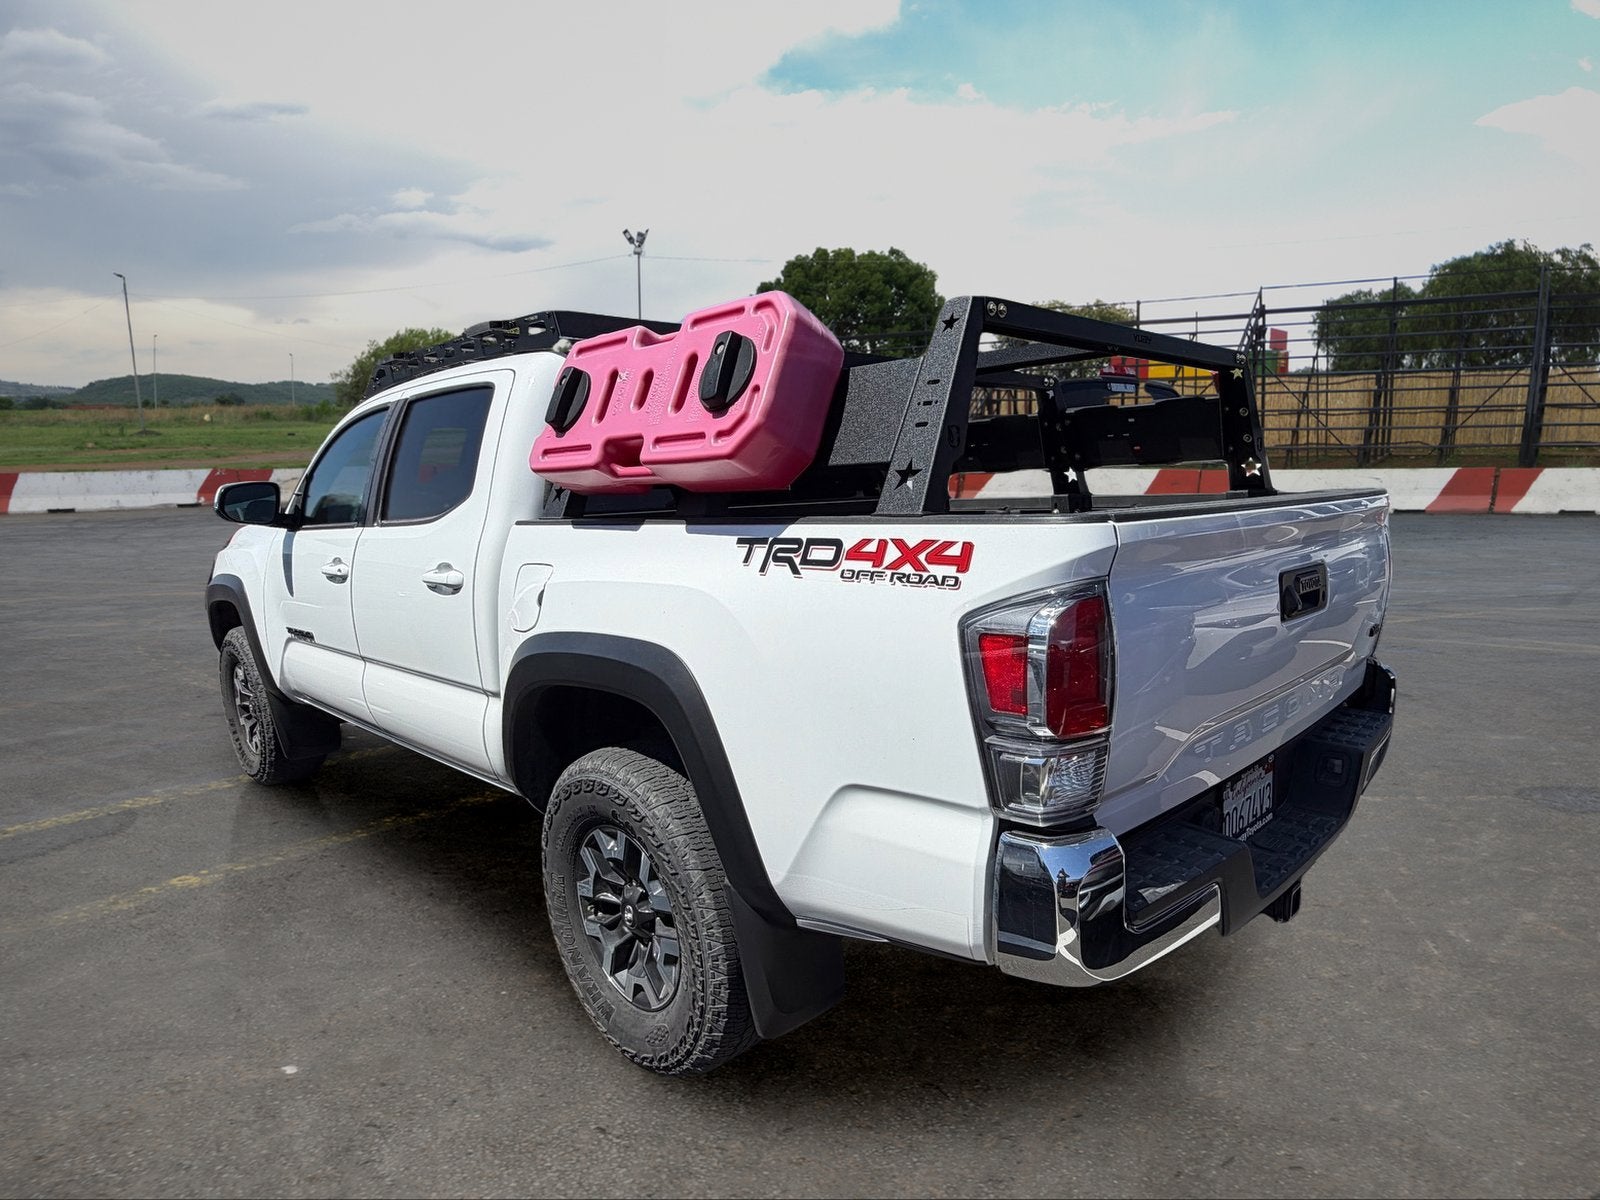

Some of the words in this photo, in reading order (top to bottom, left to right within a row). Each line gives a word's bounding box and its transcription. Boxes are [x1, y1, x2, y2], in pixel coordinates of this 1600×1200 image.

[735, 537, 846, 579] TRD
[844, 538, 976, 574] 4X4
[839, 568, 887, 584] OFF
[889, 572, 962, 591] ROAD
